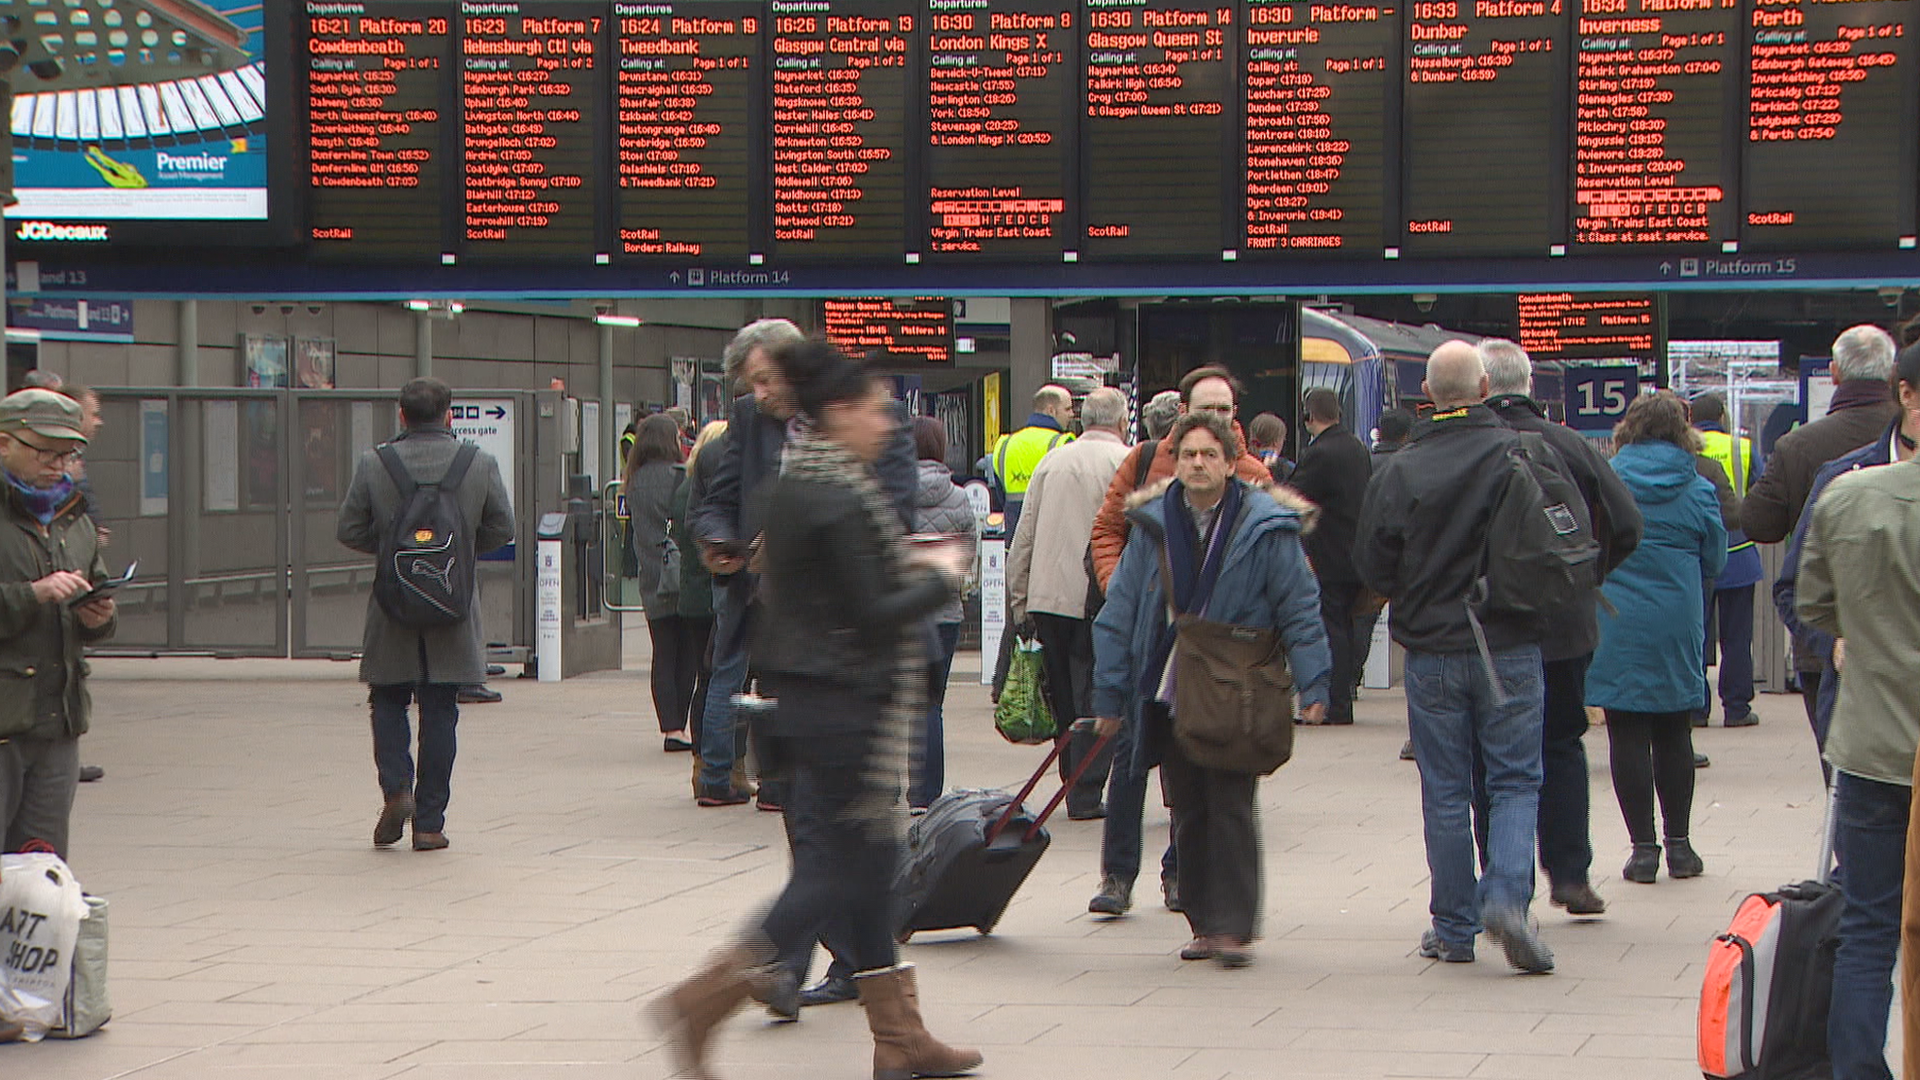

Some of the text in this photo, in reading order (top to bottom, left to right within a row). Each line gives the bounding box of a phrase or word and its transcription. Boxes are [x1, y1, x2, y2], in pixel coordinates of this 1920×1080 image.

[307, 3, 364, 13] Departures
[462, 2, 519, 14] Departures
[616, 4, 672, 15] Departures
[773, 1, 830, 12] Departures
[930, 0, 988, 10] Departures
[1415, 0, 1562, 19] 16:33 Platform 4
[933, 12, 1071, 30] 16:30 Platform 8
[1091, 9, 1232, 28] 16:30 Platform 14
[1251, 7, 1294, 24] 16:30
[1311, 5, 1379, 22] Platform
[1753, 9, 1804, 26] Perth
[312, 18, 447, 34] 16:21 Platform 20
[466, 18, 601, 34] 16:23 Platform 7
[621, 15, 758, 34] 16:24 Platform 19
[777, 16, 913, 33] 16:26 Platform 13
[1412, 23, 1468, 40] Dunbar
[1579, 17, 1662, 34] Inverness
[931, 33, 1047, 51] London Kings X
[1088, 29, 1223, 50] Glasgow Queen St
[1248, 28, 1321, 44] Inverurie
[309, 38, 405, 54] Cowdenbeath
[464, 39, 544, 56] Helensburgh
[572, 38, 594, 54] via
[620, 38, 699, 54] Tweedbank
[774, 36, 907, 55] Glasgow Central via
[466, 57, 593, 70] Calling at: Page 1 of 2
[621, 57, 748, 70] Calling at: Page 1 of 1
[1248, 58, 1385, 74] Calling at: Page 1 of 1
[1411, 54, 1476, 69] Musselburgh
[619, 69, 670, 82] Brunstane
[1579, 63, 1616, 77] Falkirk
[1619, 64, 1682, 75] Grahamston
[311, 111, 339, 120] North
[341, 111, 403, 123] Queensferry
[465, 111, 514, 123] Livingston
[516, 111, 545, 121] North
[931, 108, 954, 119] York
[1088, 106, 1096, 116] &
[1099, 105, 1140, 118] Glasgow
[1141, 105, 1171, 115] Queen
[1174, 104, 1187, 115] St
[1578, 121, 1628, 134] Pitlochry
[1750, 115, 1801, 128] Ladybank
[311, 123, 375, 136] Inverkeithing
[1750, 130, 1760, 141] &
[1762, 126, 1795, 140] Perth
[931, 135, 939, 145] &
[941, 132, 977, 145] London
[978, 134, 1003, 146] Kings
[1006, 134, 1014, 144] X
[1248, 143, 1313, 153] Laurencekirk
[157, 151, 228, 171] Premier
[775, 150, 826, 162] Livingston
[827, 149, 857, 160] South
[1247, 170, 1302, 181] Portlethen
[931, 187, 1020, 198] Reservation Level
[1748, 213, 1794, 224] ScotRail
[17, 221, 108, 240] JCDecaux
[931, 226, 1052, 240] Virgin Trains East Coast
[1089, 226, 1128, 237] ScotRail
[624, 242, 700, 253] Borders Railway
[1247, 236, 1342, 248] FRONT 3 CARRIAGES
[1705, 258, 1796, 274] Platform 15
[68, 270, 87, 284] 13
[710, 270, 789, 284] Platform 14
[1601, 314, 1638, 325] Platform
[901, 325, 934, 335] Platform
[905, 388, 919, 416] 14
[1576, 380, 1627, 416] 15
[451, 425, 498, 436] ccess gate
